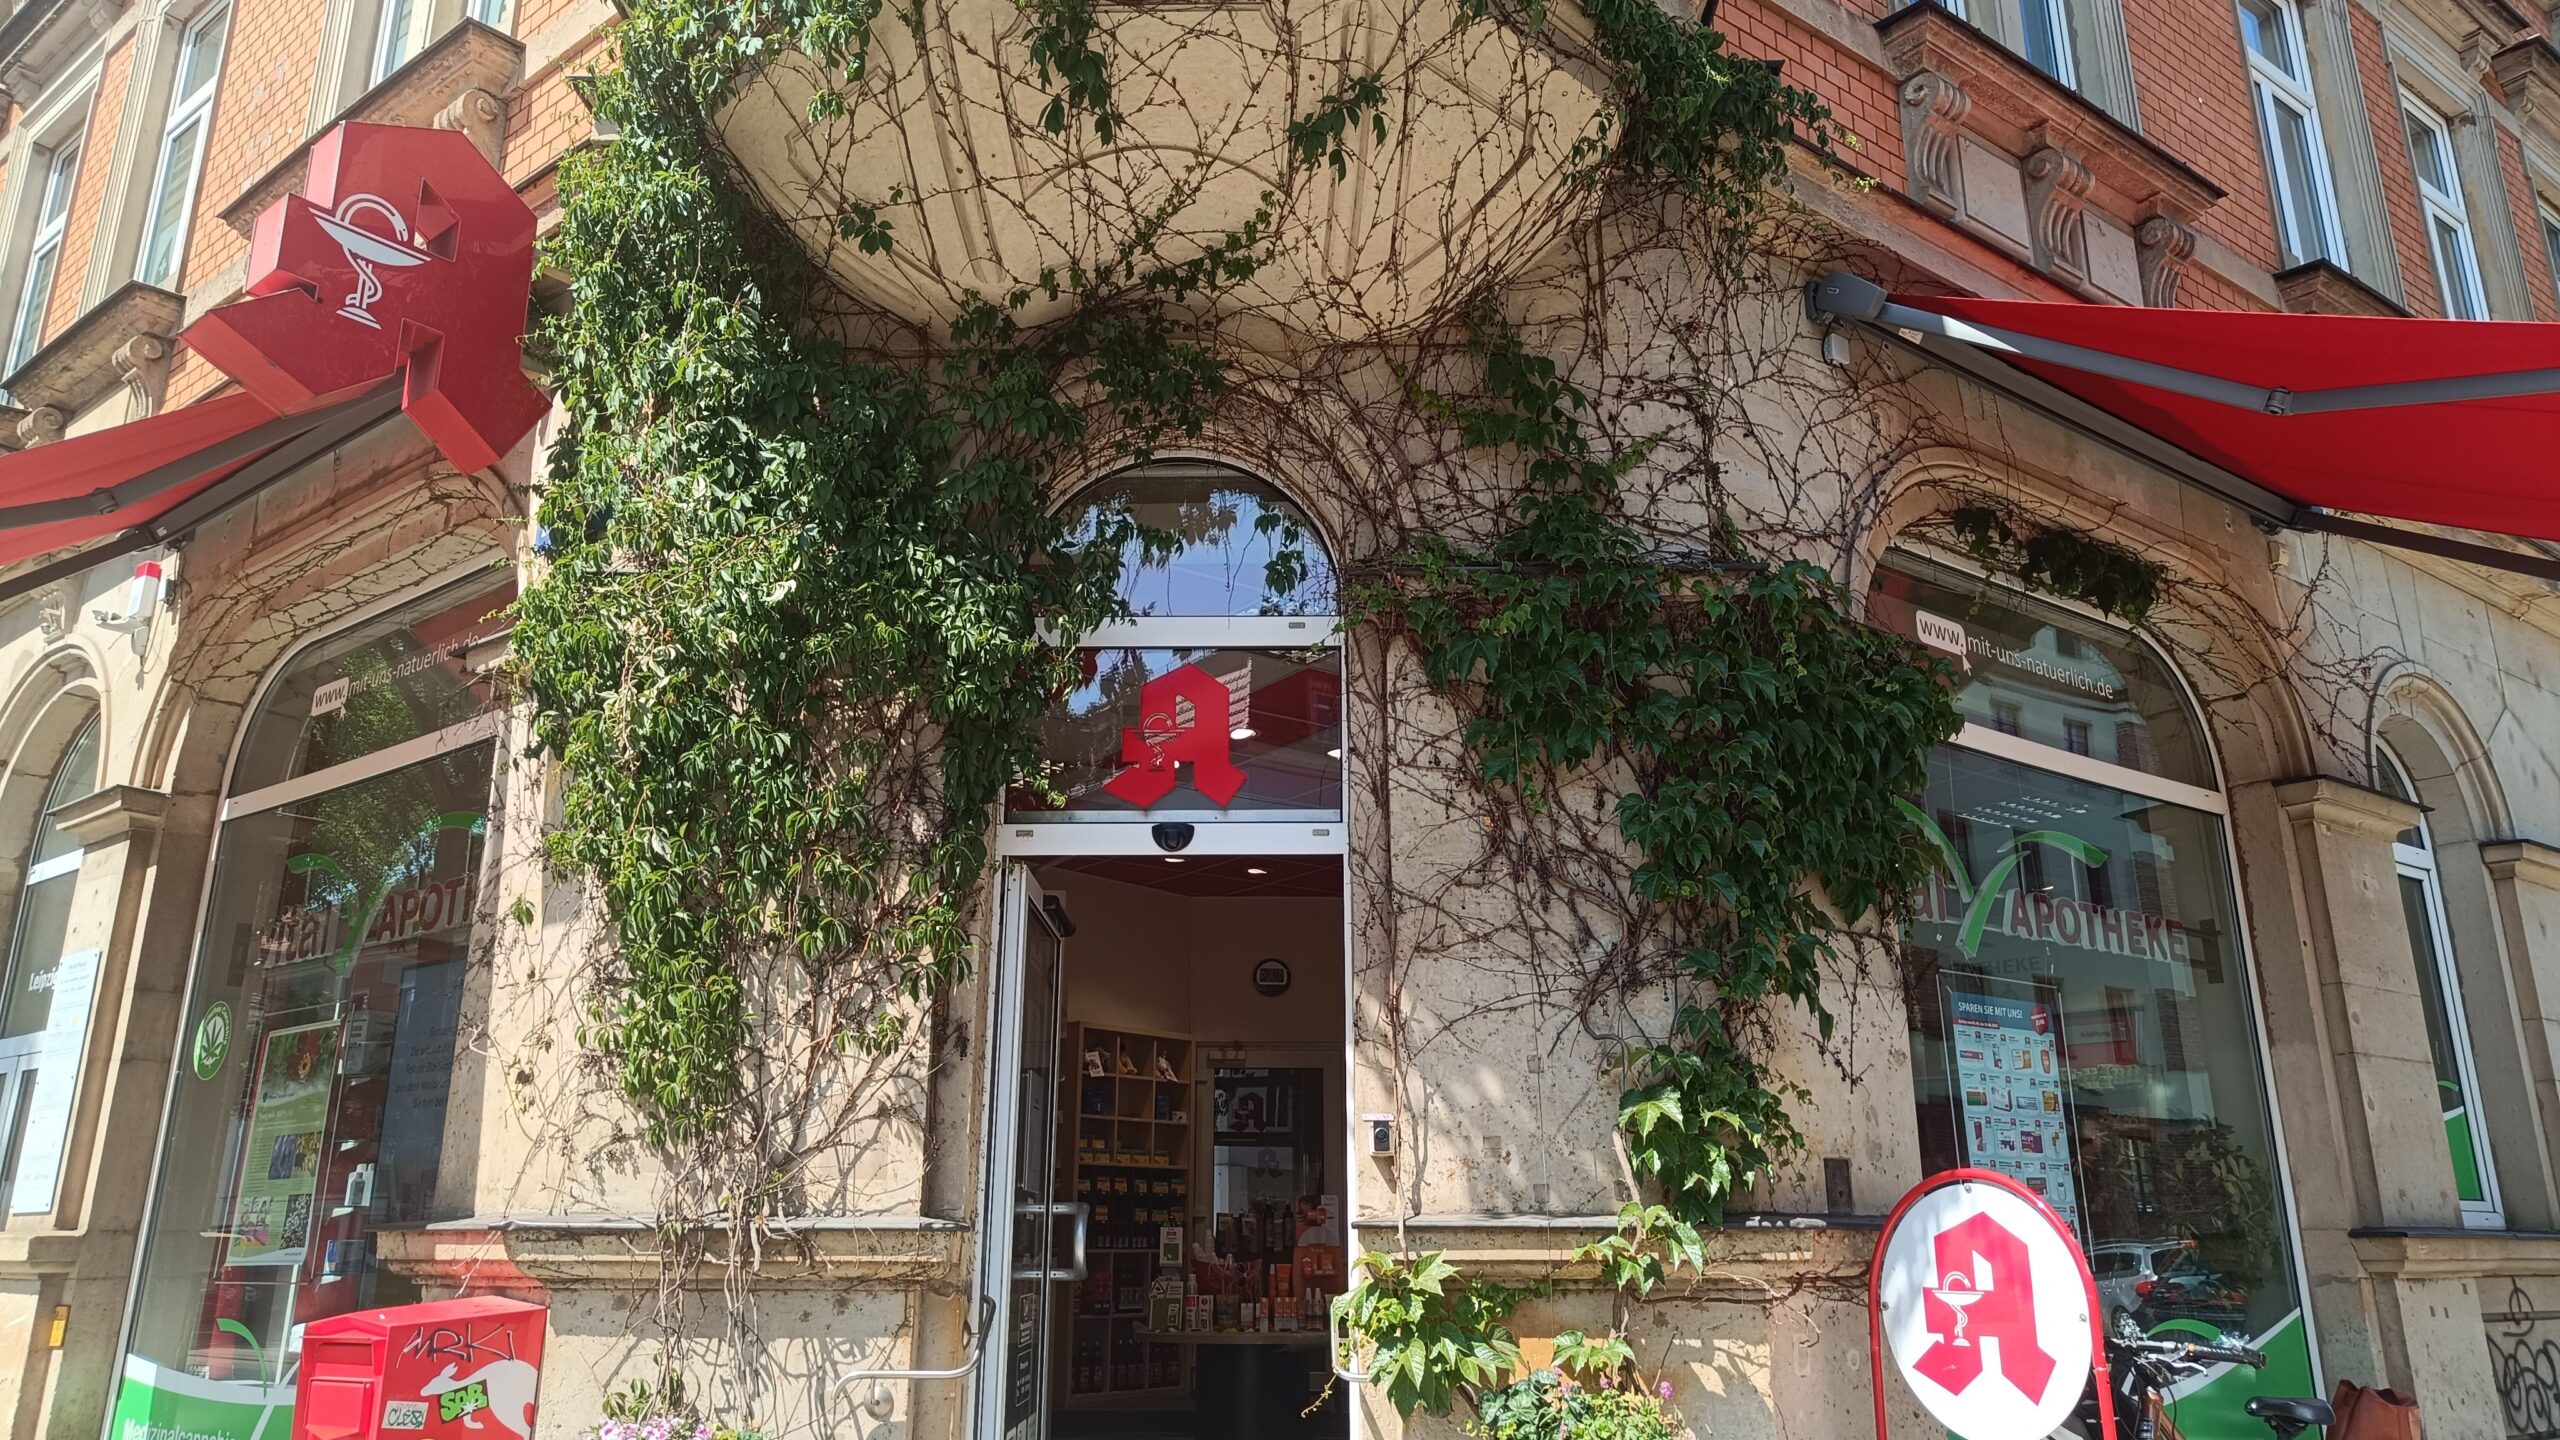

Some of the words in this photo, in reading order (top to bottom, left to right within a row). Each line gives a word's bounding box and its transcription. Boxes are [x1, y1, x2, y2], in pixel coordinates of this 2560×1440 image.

[314, 632, 479, 709] www.mit-uns-natuerlichde
[1918, 617, 2114, 699] www.mit-uns-natuerlich.de
[2005, 889, 2188, 964] APOTHEKE
[1958, 1002, 1983, 1014] SPAREN
[1984, 1005, 1994, 1015] SIE
[1995, 1006, 2007, 1017] MIT
[2007, 1008, 2023, 1019] UNS!
